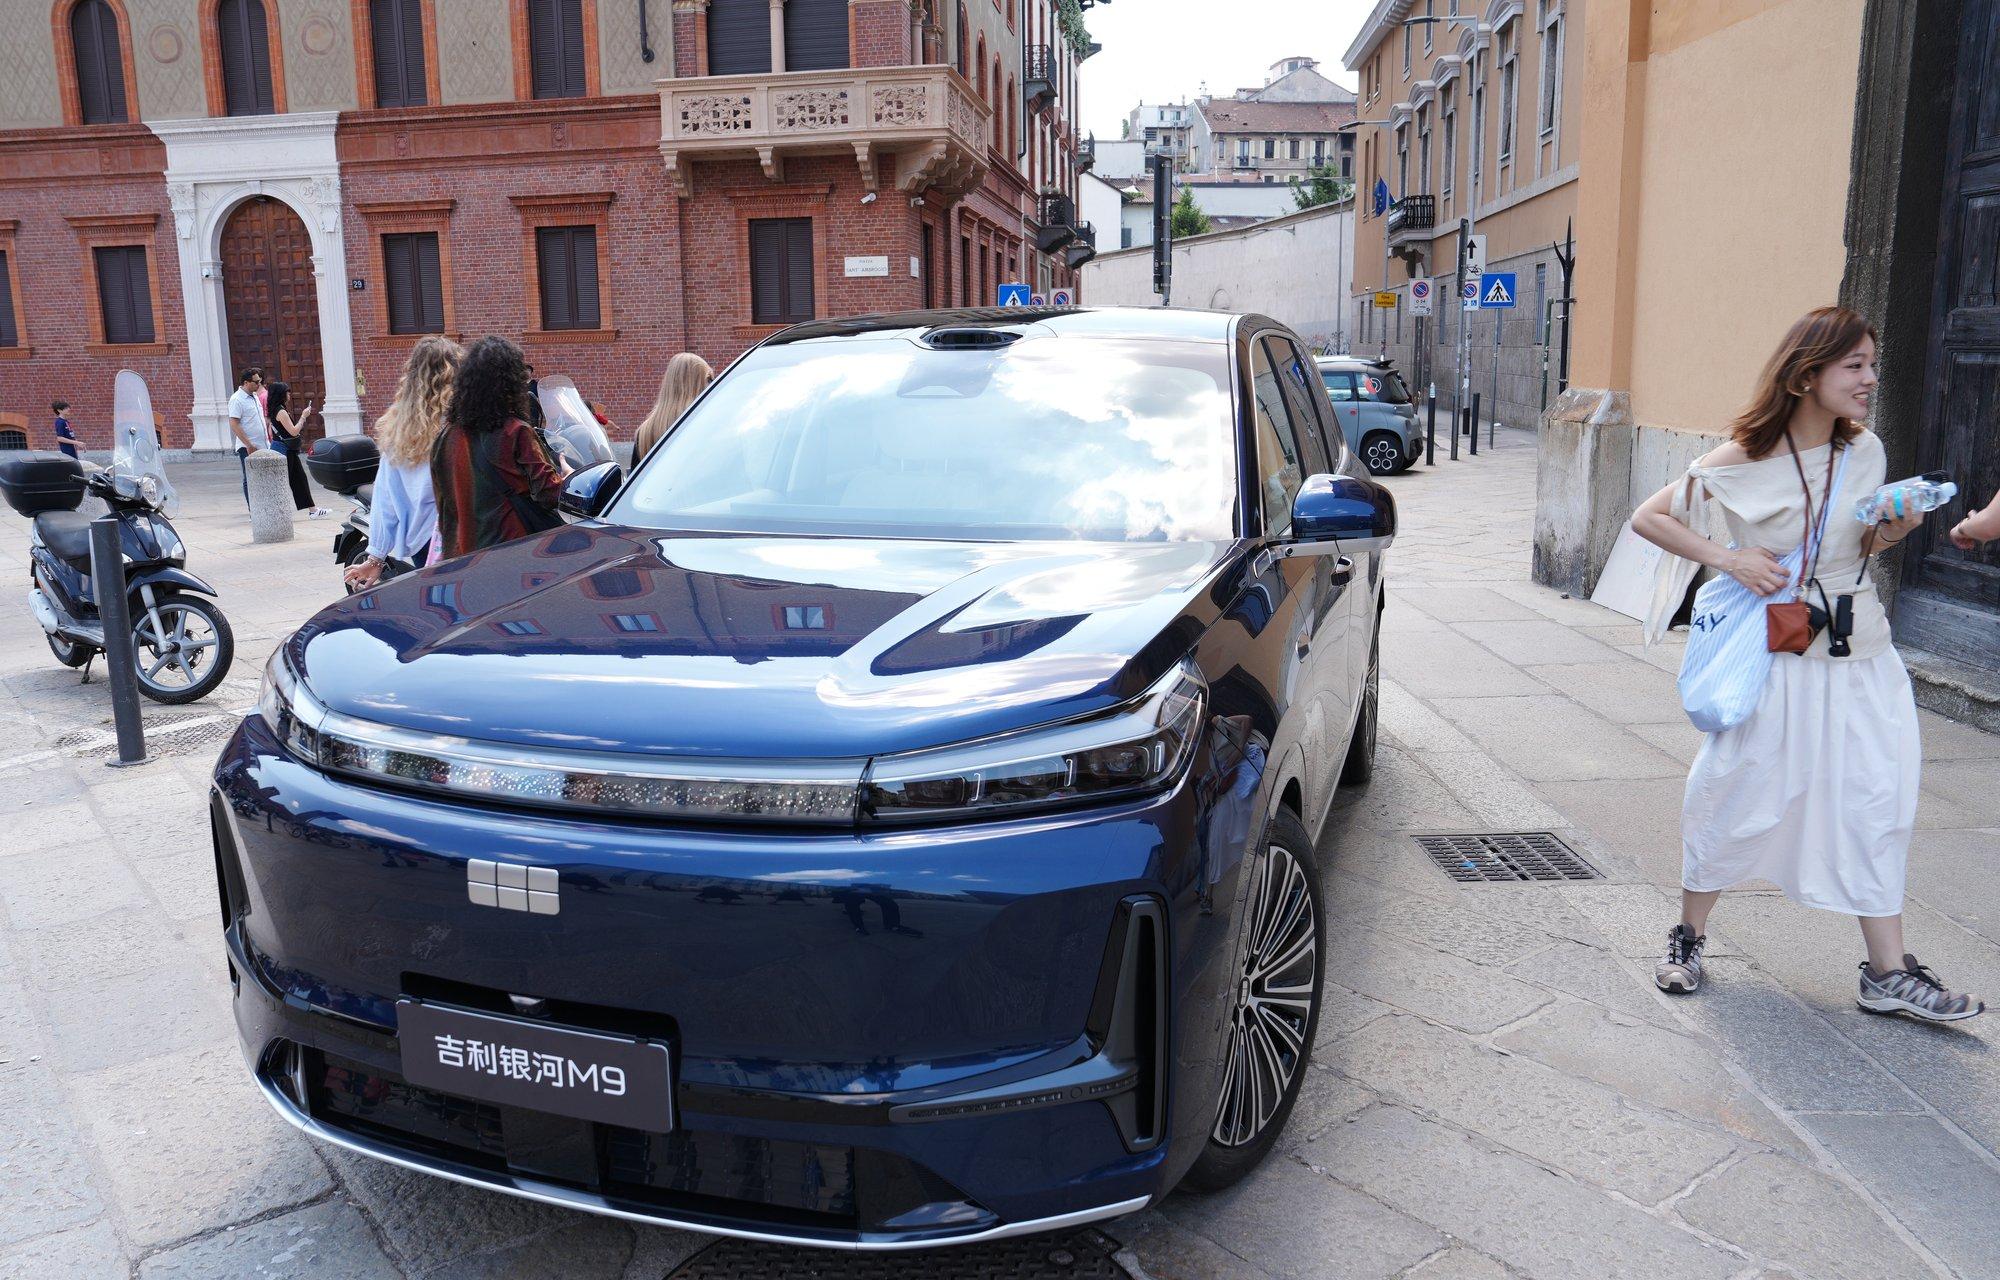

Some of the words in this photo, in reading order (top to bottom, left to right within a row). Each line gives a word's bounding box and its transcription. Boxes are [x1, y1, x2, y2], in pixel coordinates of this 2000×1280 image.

[352, 280, 363, 289] 29
[434, 1033, 627, 1097] 吉利银河M9
